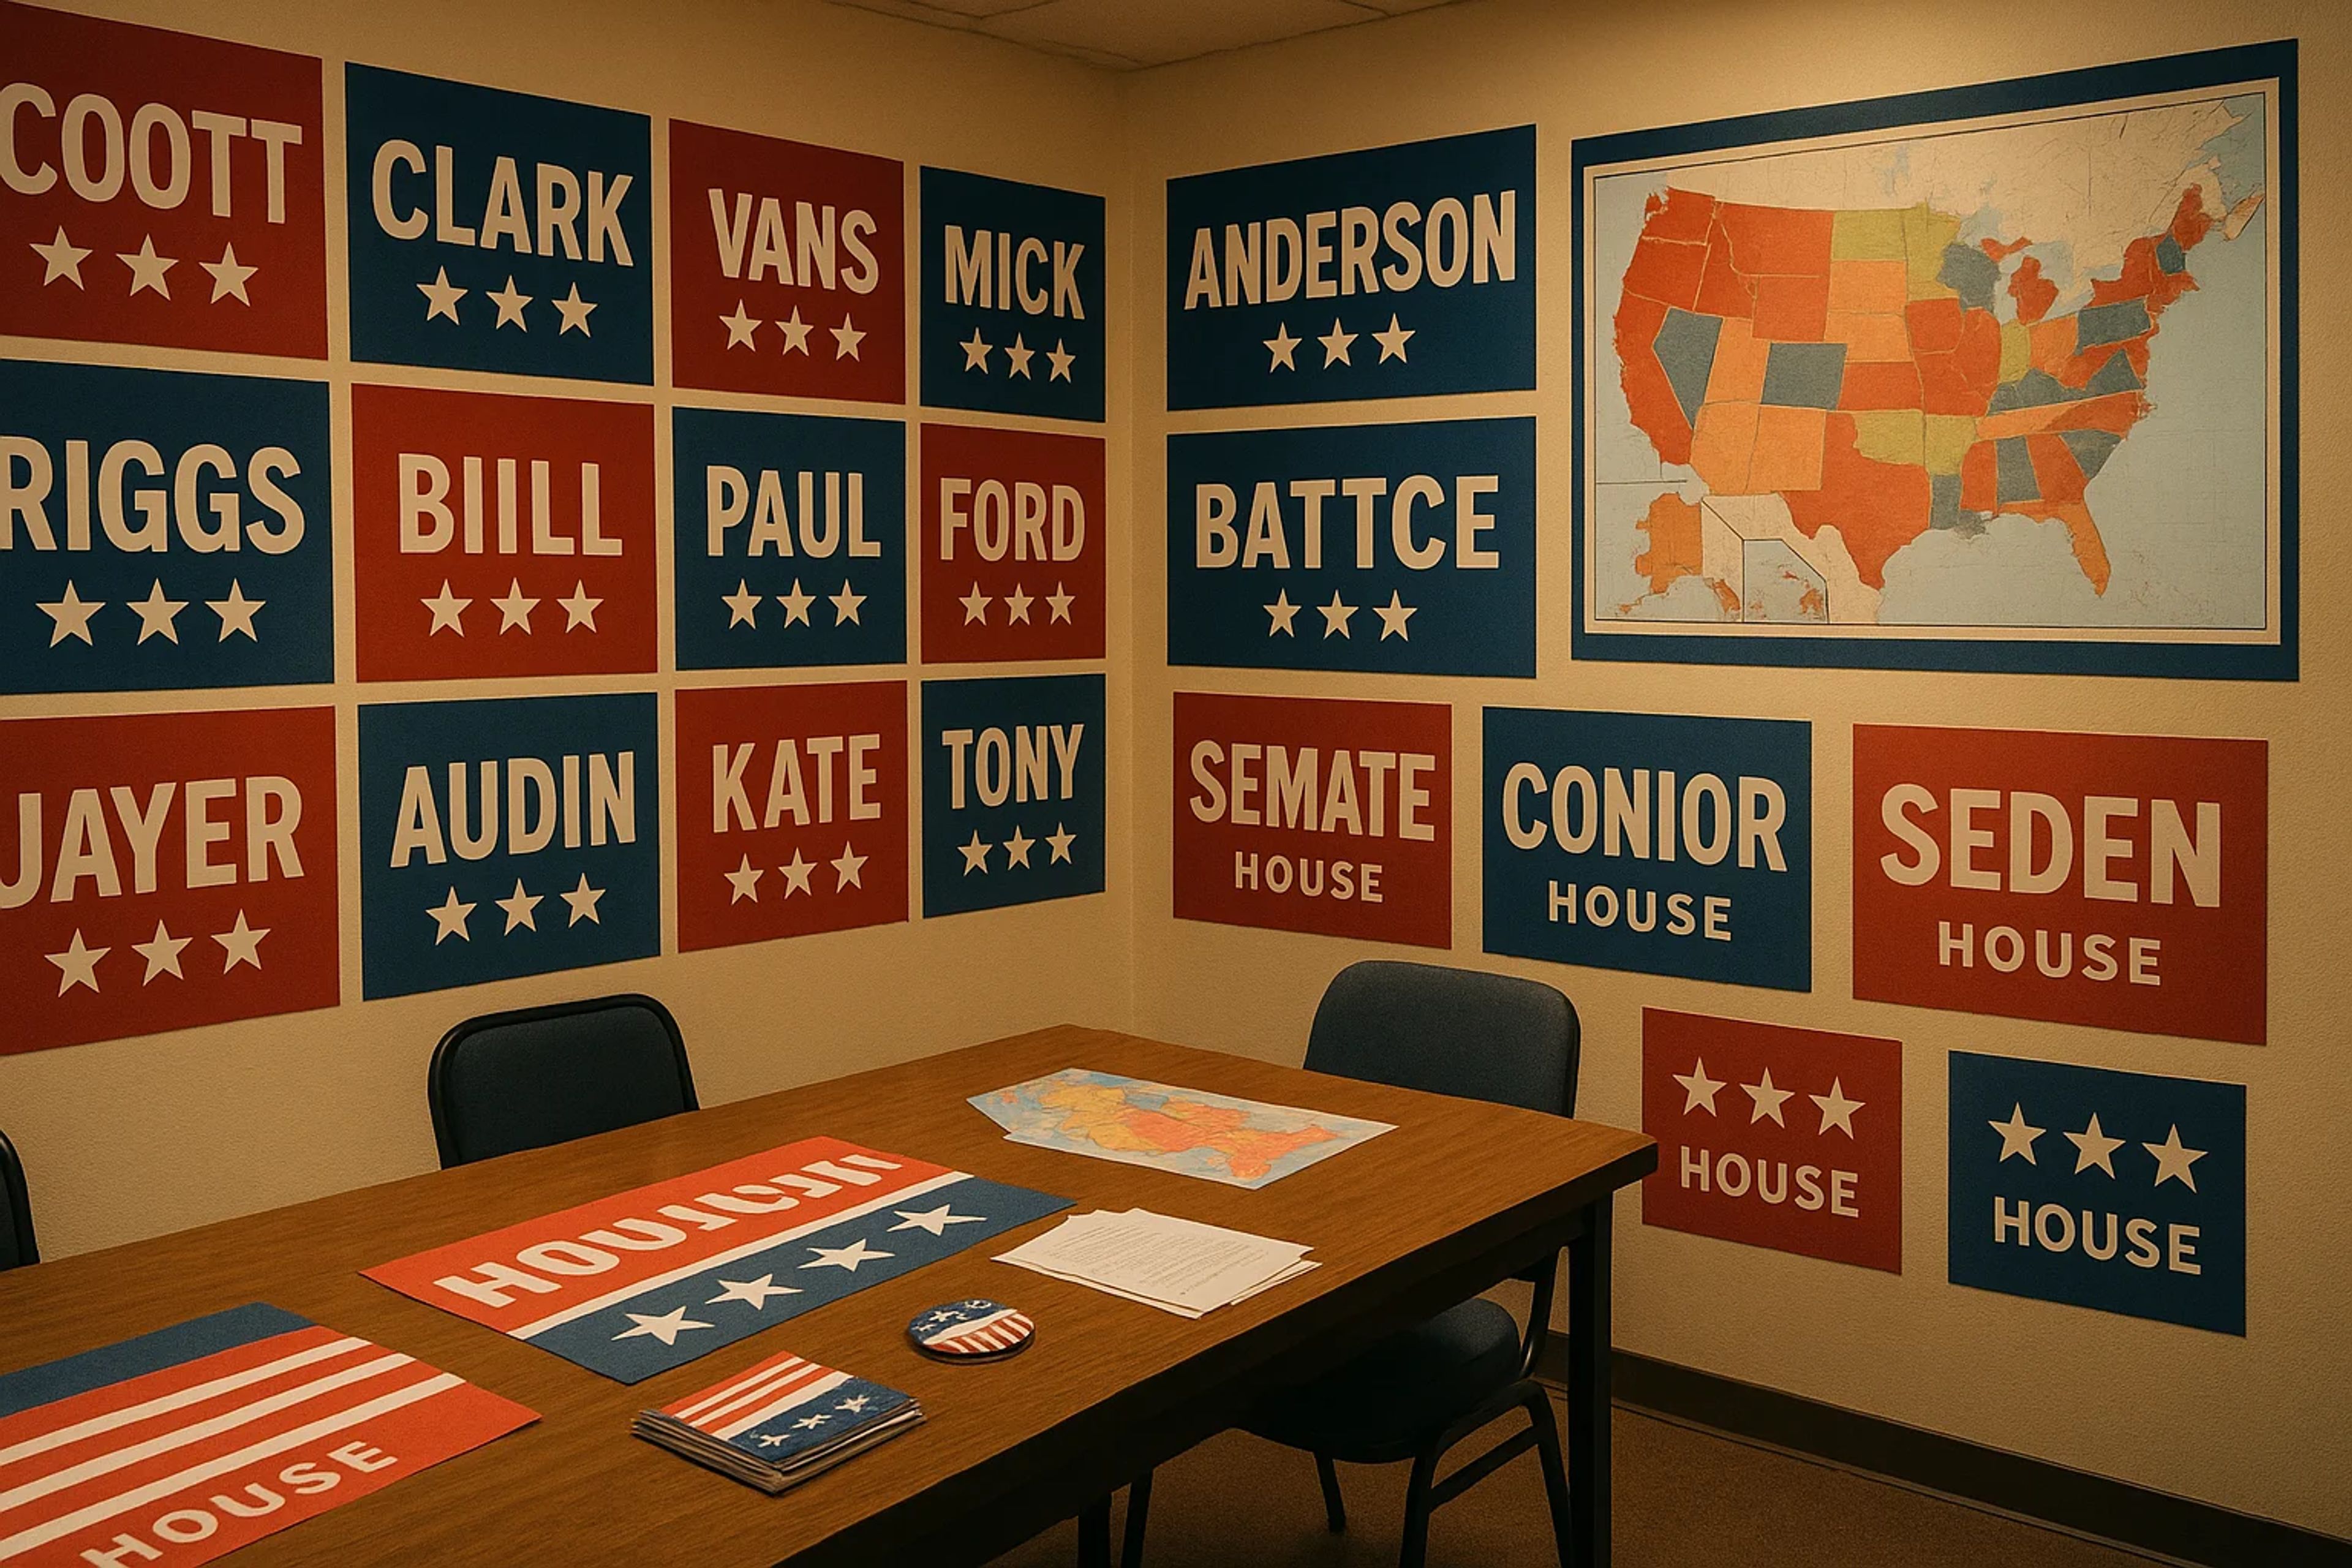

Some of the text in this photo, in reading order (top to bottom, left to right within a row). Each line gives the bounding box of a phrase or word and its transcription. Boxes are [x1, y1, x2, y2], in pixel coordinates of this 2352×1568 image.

[0, 83, 302, 224] COOTT
[372, 140, 633, 266] CLARK
[709, 189, 878, 294] VANS
[945, 225, 1085, 319] MICK
[1185, 190, 1515, 309] ANDERSON
[0, 436, 304, 554] RIGGS
[399, 453, 622, 556] BIILL
[707, 466, 881, 557] PAUL
[941, 478, 1085, 561] FORD
[1197, 475, 1499, 569] BATTCE
[391, 752, 635, 867] AUDIN
[713, 734, 880, 833] KATE
[942, 724, 1084, 809] TONY
[1190, 741, 1435, 841] SEMATE
[1503, 763, 1787, 872] CONIOR
[1881, 784, 2220, 907] SEDEN
[1236, 851, 1382, 902] HOUSE
[1550, 881, 1731, 941] HOUSE
[1939, 921, 2160, 986] HOUSE
[1681, 1146, 1858, 1218] HOUSE
[1995, 1196, 2201, 1275] HOUSE
[78, 1440, 398, 1568] HOUSE
